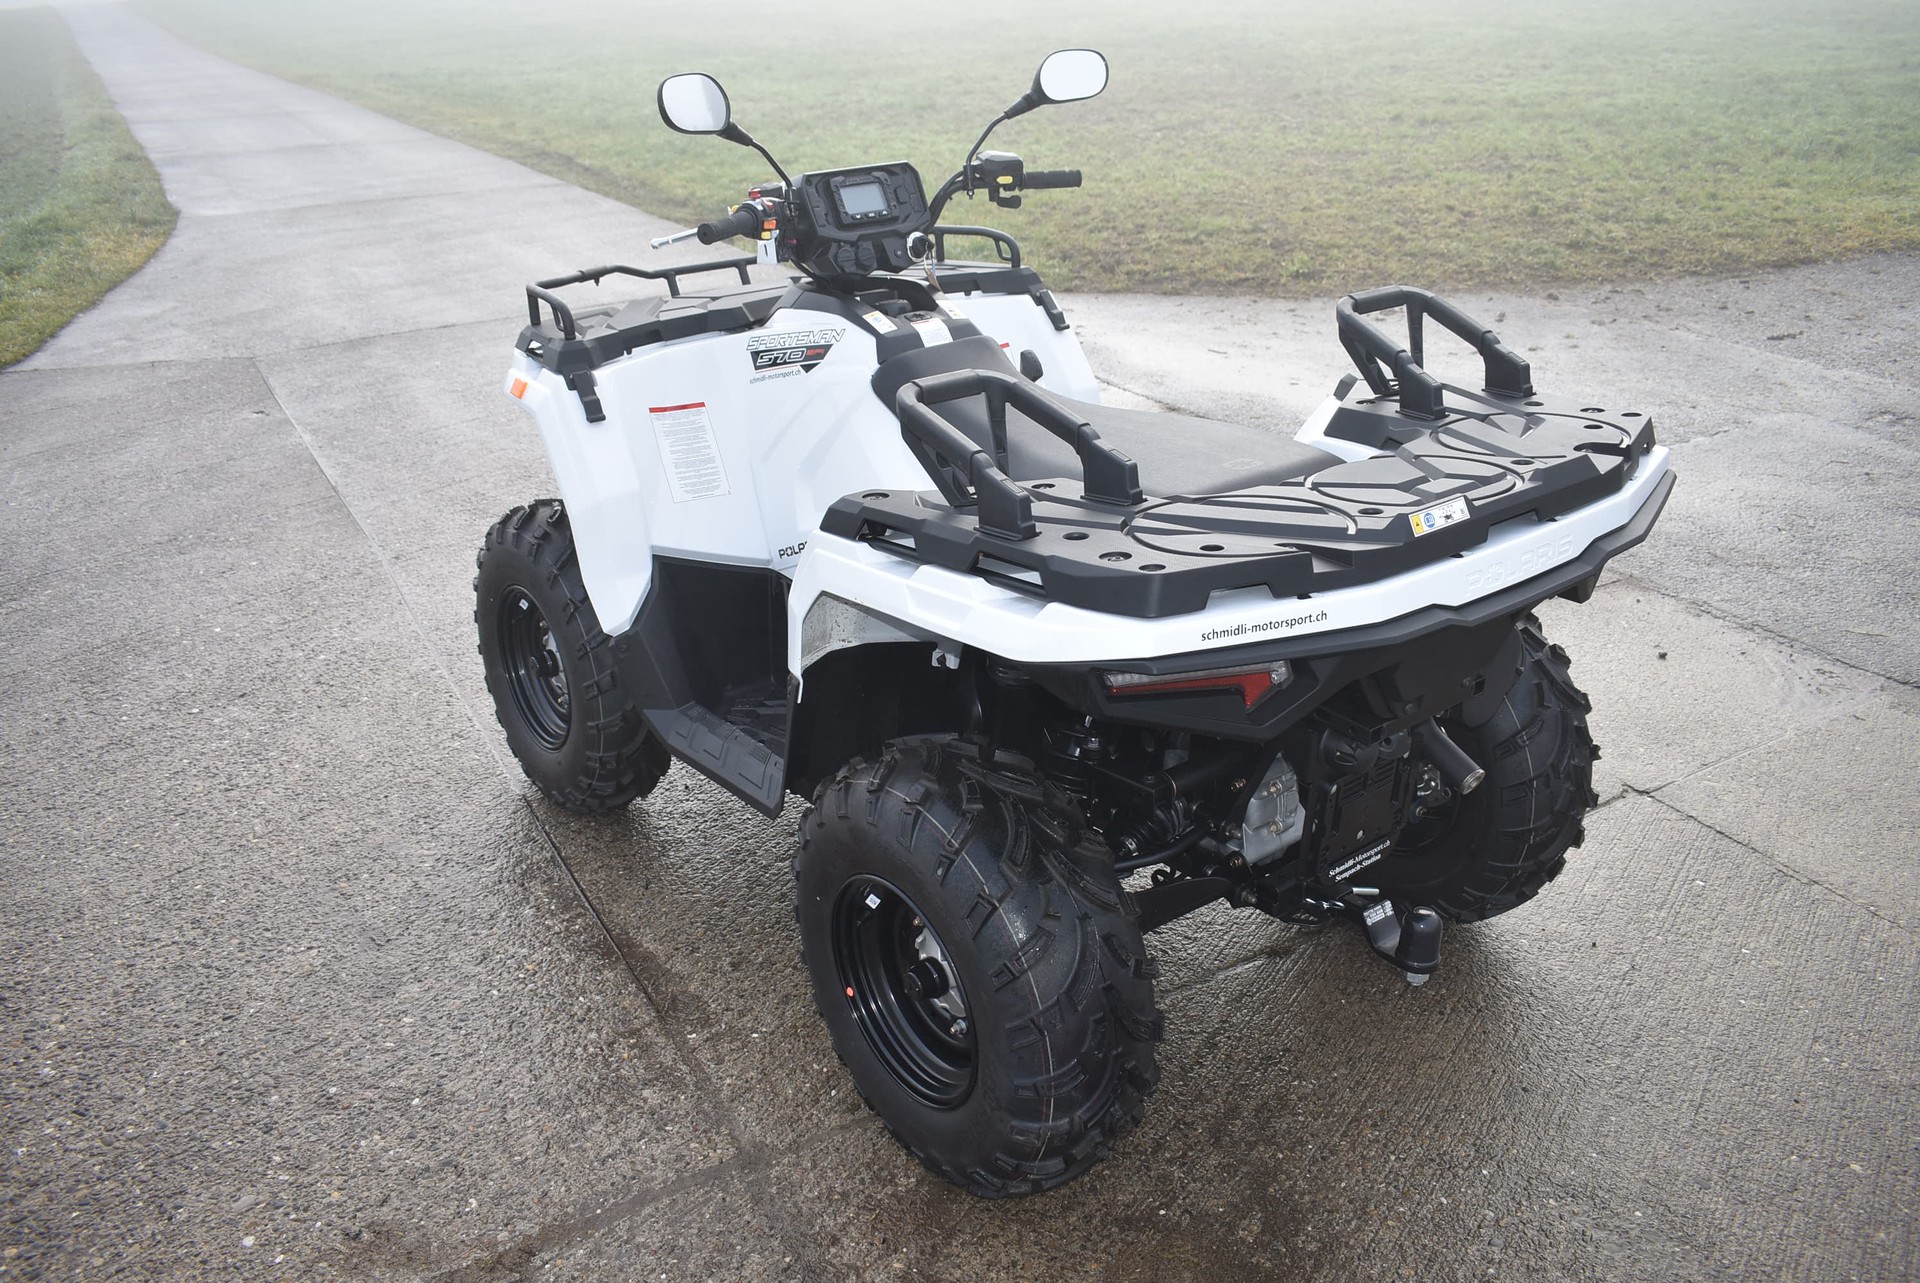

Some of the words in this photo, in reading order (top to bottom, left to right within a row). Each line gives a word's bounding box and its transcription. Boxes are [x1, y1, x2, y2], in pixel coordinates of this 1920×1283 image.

[746, 328, 846, 351] SPORTSMAN
[756, 348, 806, 366] 570
[778, 541, 807, 560] POLA
[1465, 533, 1574, 598] POLARIS
[1201, 610, 1328, 641] schmidli-motorsport.ch
